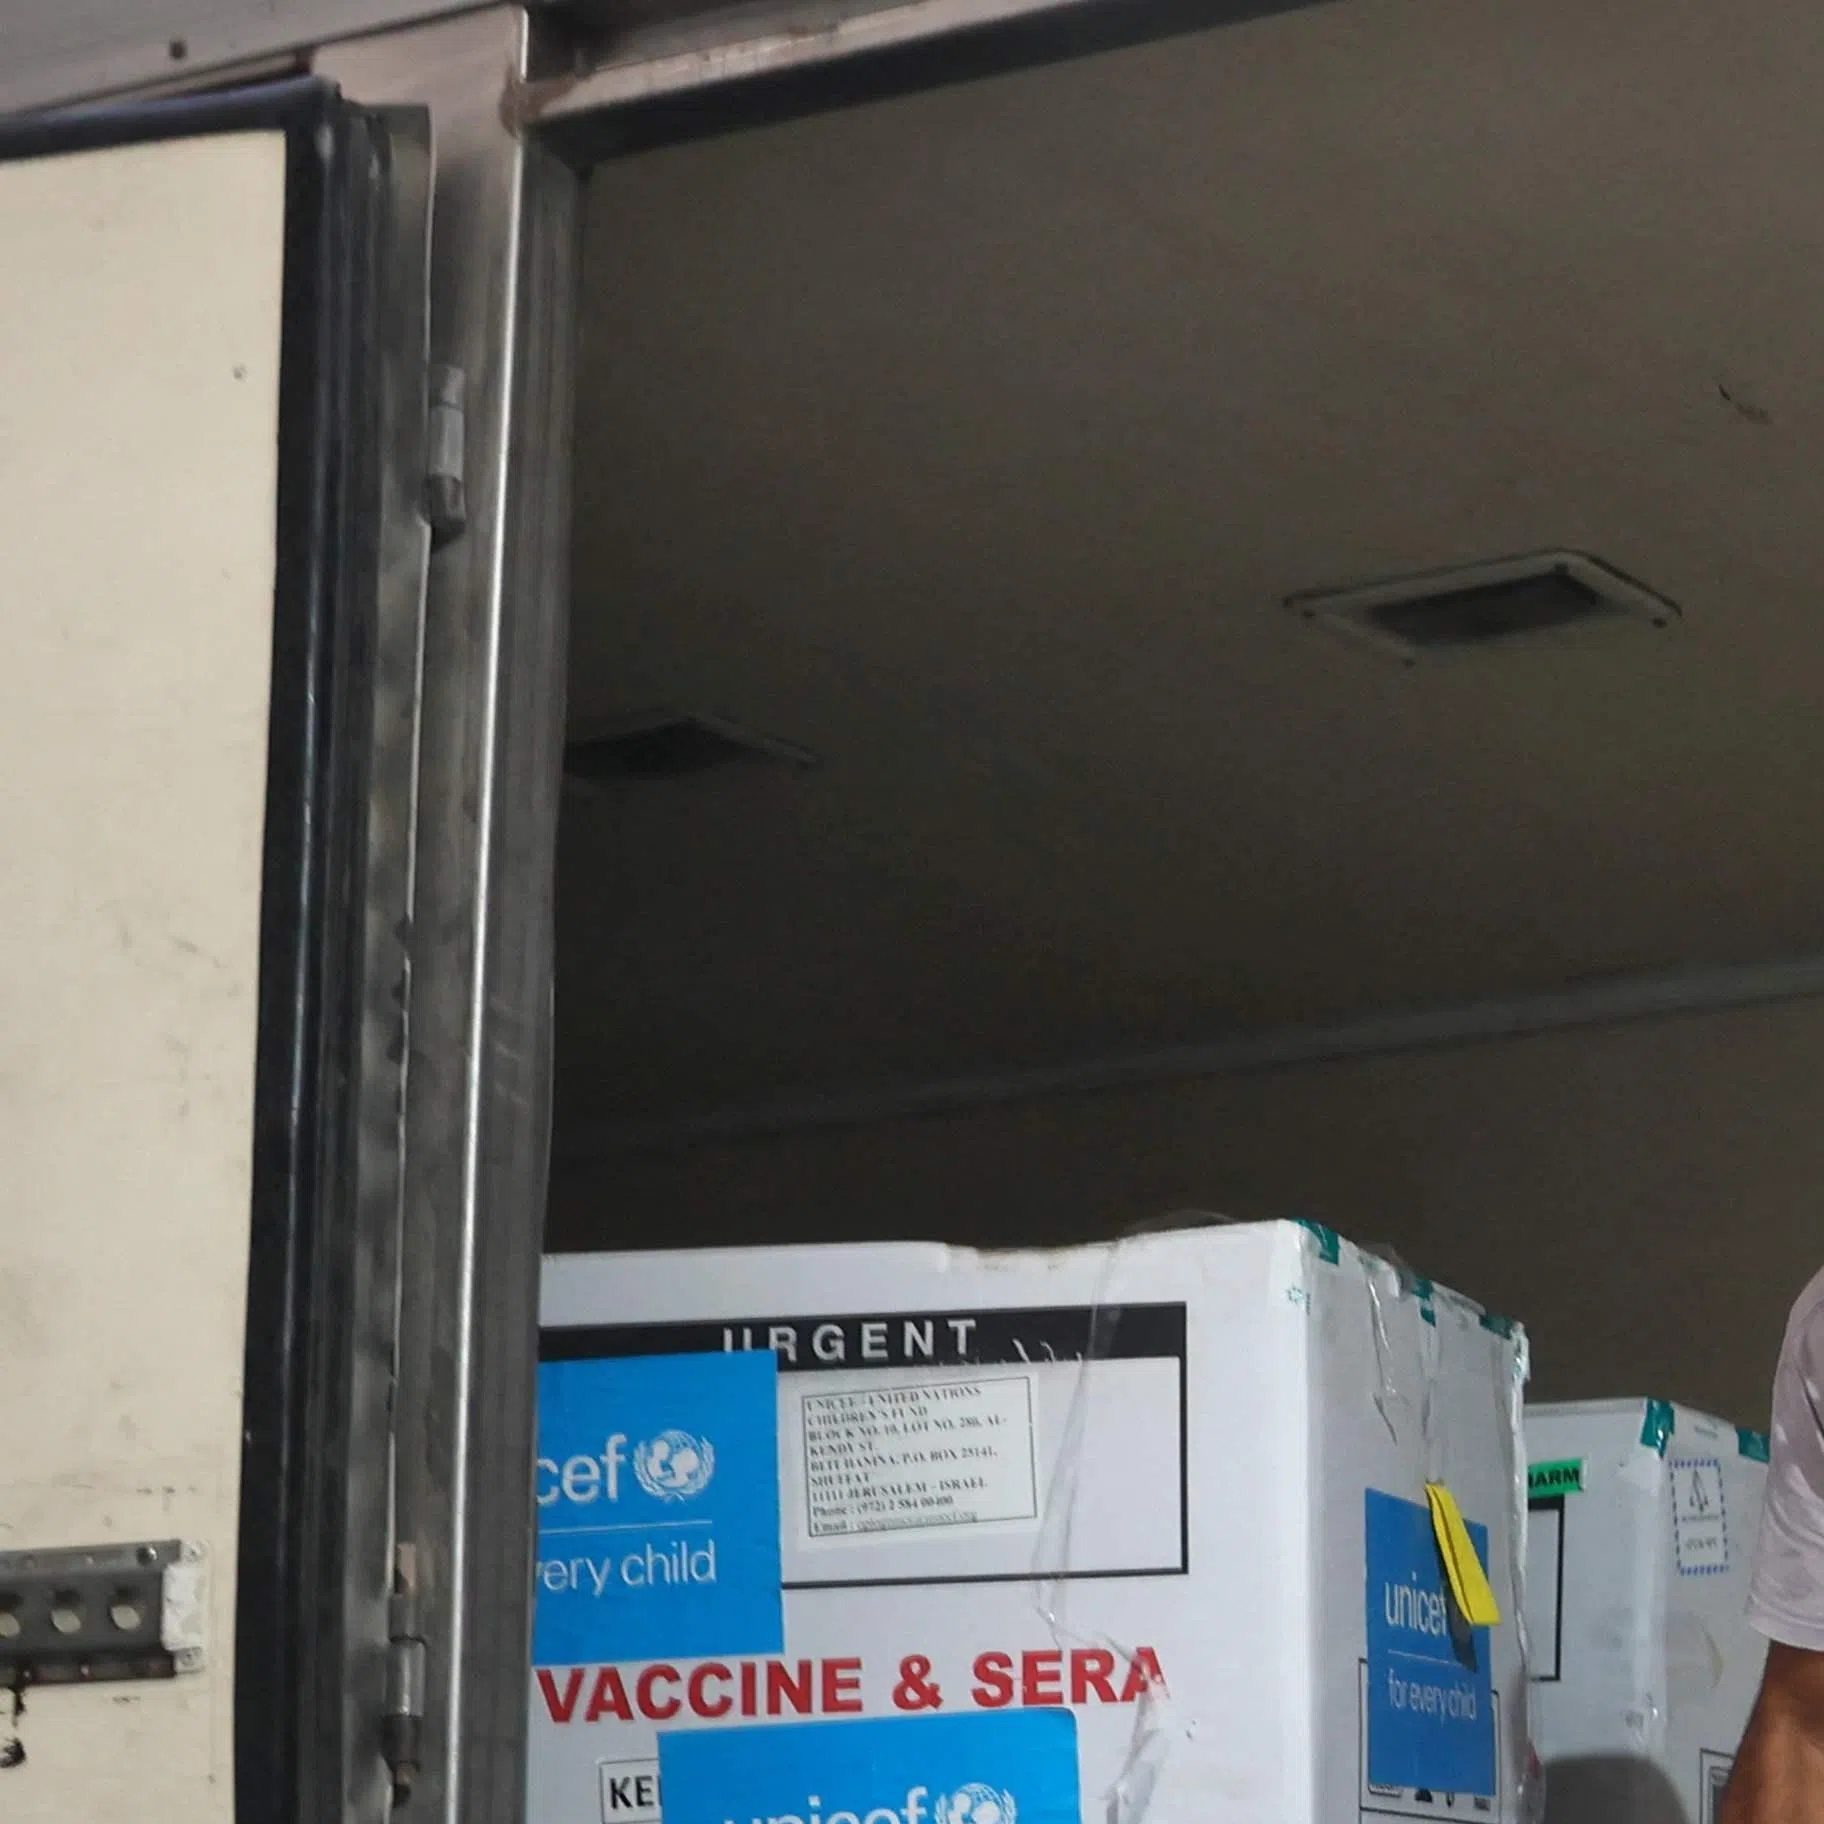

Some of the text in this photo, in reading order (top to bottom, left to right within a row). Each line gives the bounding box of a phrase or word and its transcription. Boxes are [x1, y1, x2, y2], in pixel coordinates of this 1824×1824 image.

[537, 1540, 717, 1597] ery child
[534, 1645, 1167, 1725] VACCINE & SERA
[1388, 1668, 1477, 1724] for every child
[608, 1774, 661, 1812] KE
